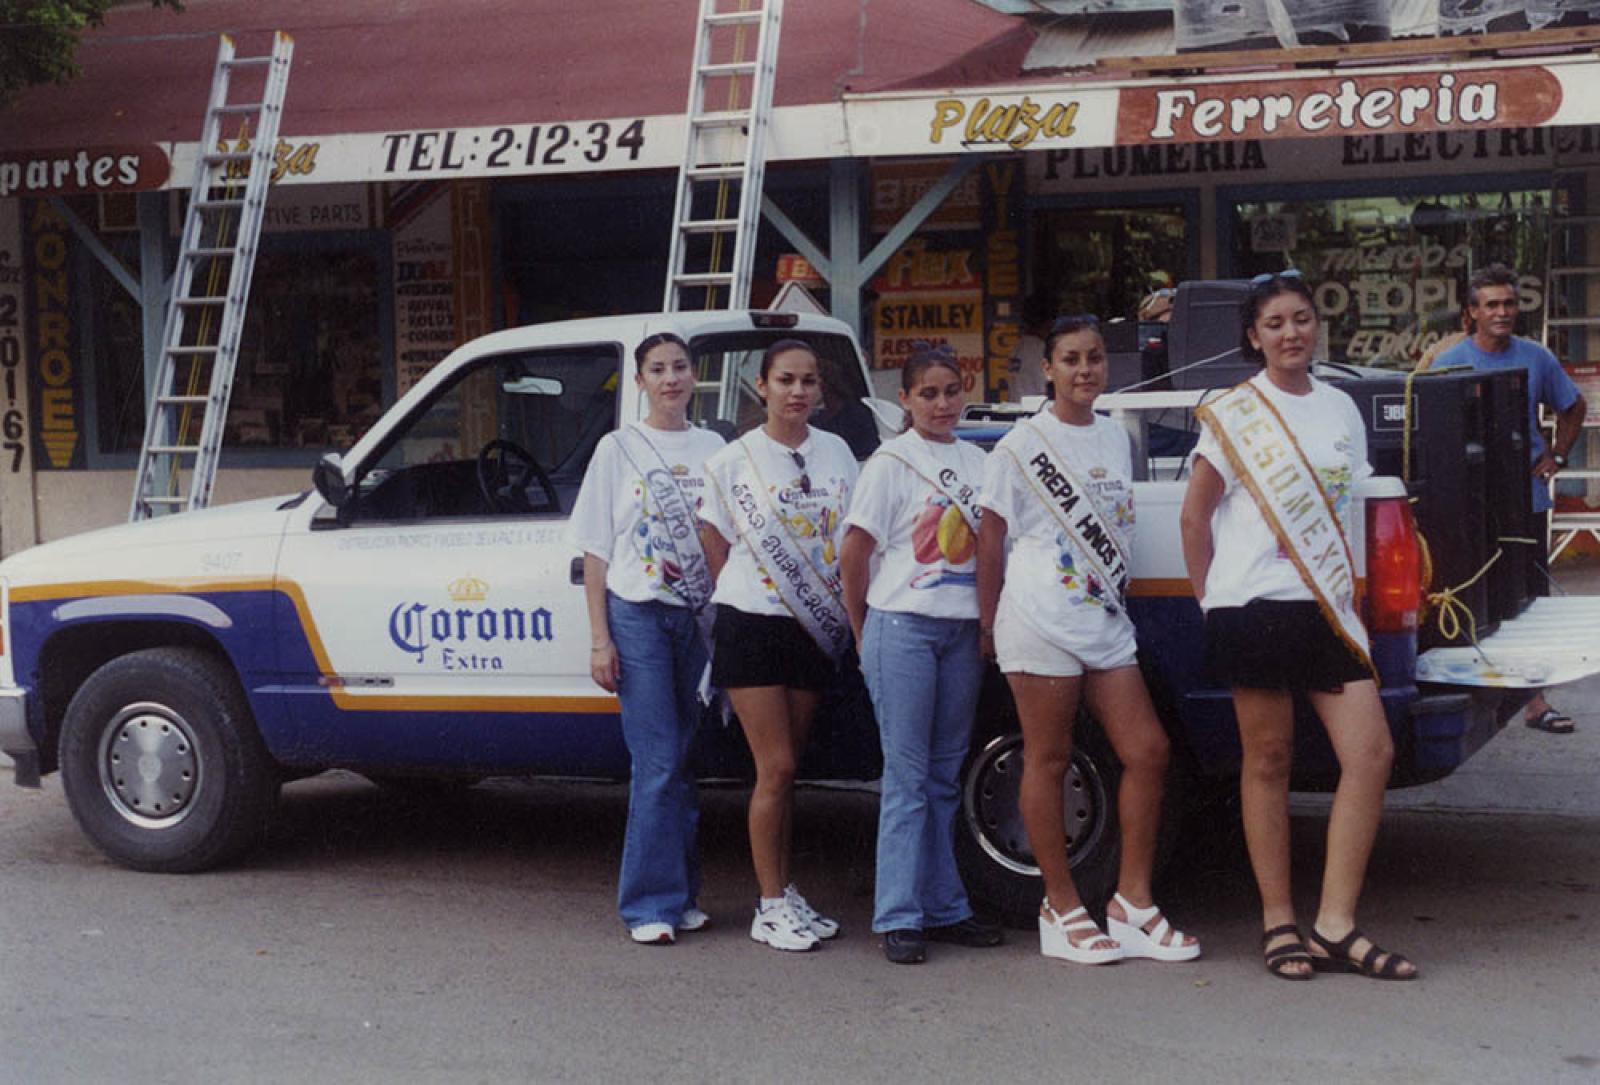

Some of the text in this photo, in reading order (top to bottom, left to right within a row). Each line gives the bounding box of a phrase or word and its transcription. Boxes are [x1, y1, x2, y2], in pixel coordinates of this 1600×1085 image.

[929, 96, 1080, 149] Plaza
[1150, 73, 1499, 140] Ferreteria
[0, 152, 141, 192] partes
[310, 203, 363, 224] PARTS
[880, 303, 975, 330] STANLEY
[388, 602, 554, 663] Corona
[442, 648, 504, 671] Extra
